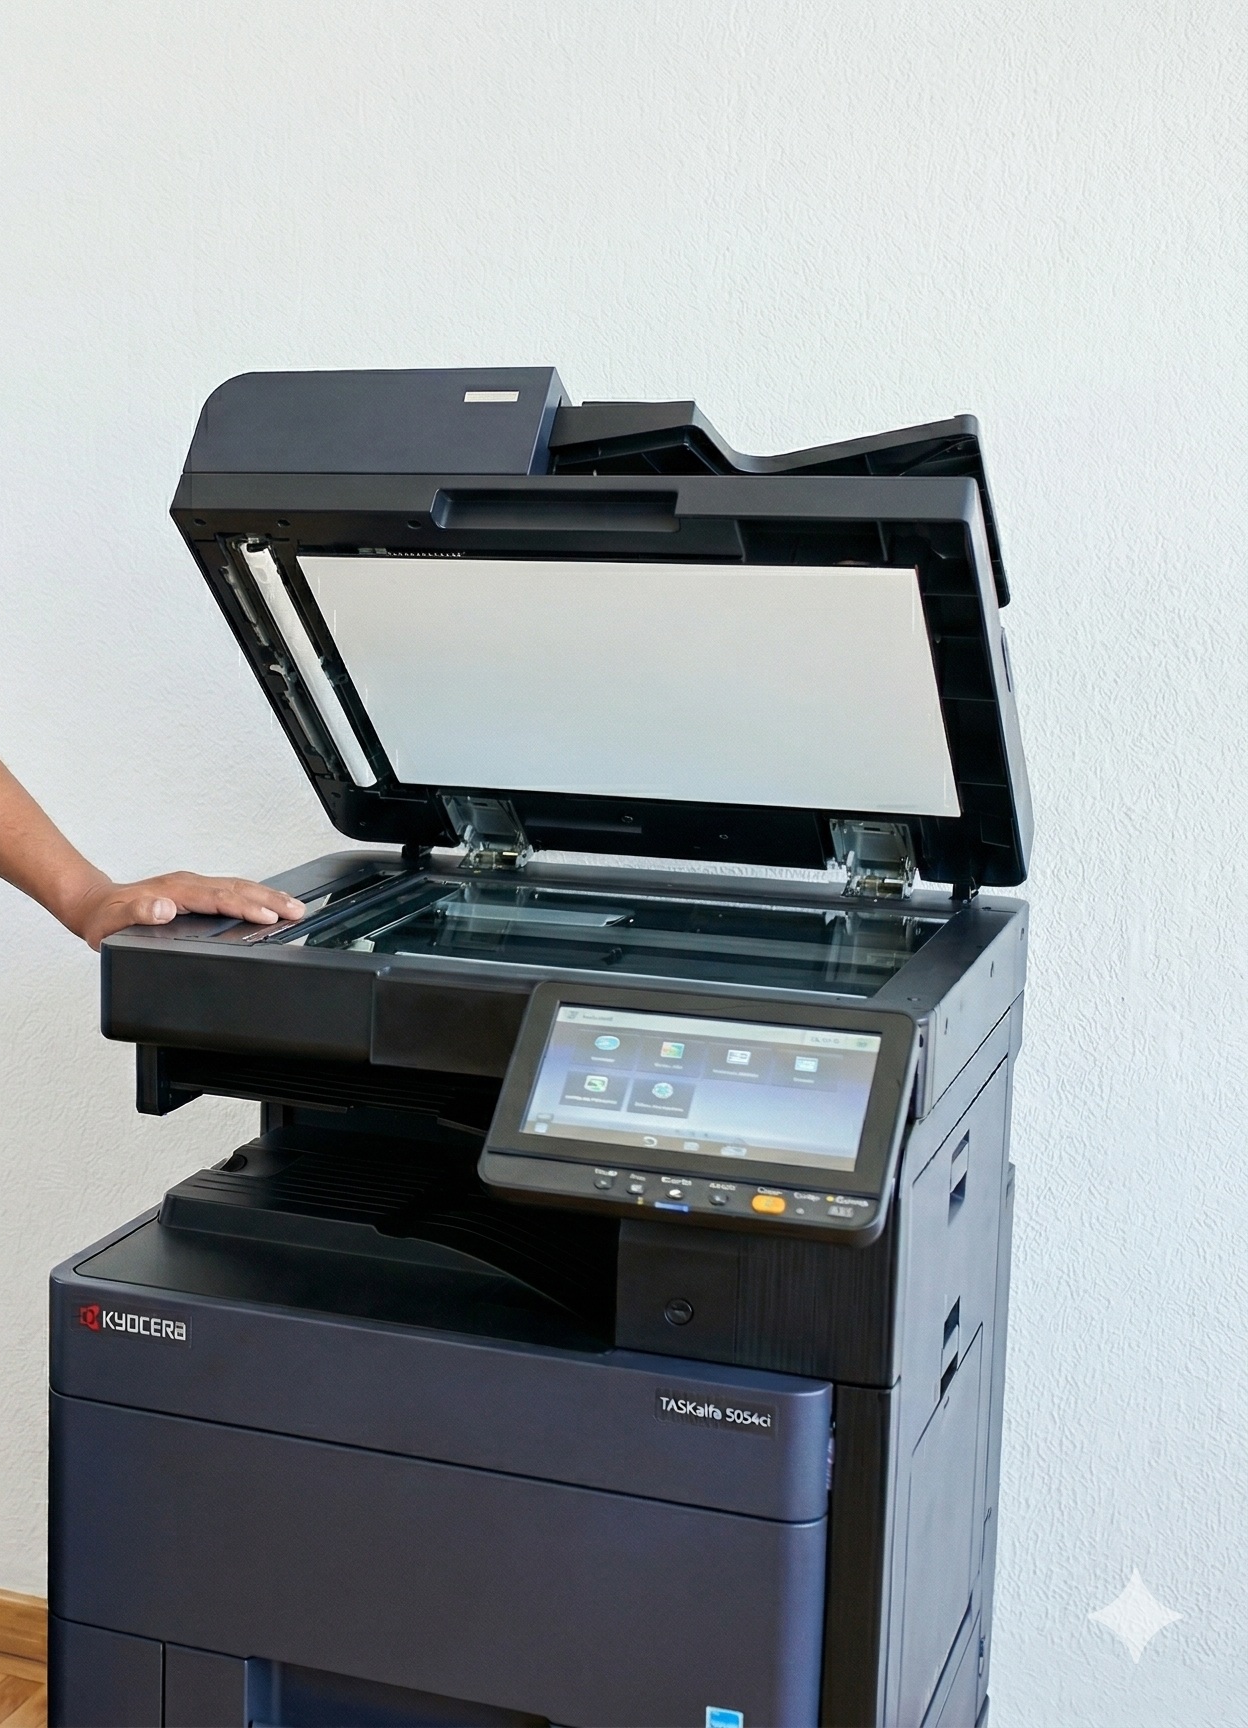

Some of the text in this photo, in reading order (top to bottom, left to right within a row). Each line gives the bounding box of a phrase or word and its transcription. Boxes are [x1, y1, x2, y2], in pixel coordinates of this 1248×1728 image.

[102, 1310, 187, 1341] KYOCERA
[660, 1396, 772, 1428] TASKalfa 5054ci
